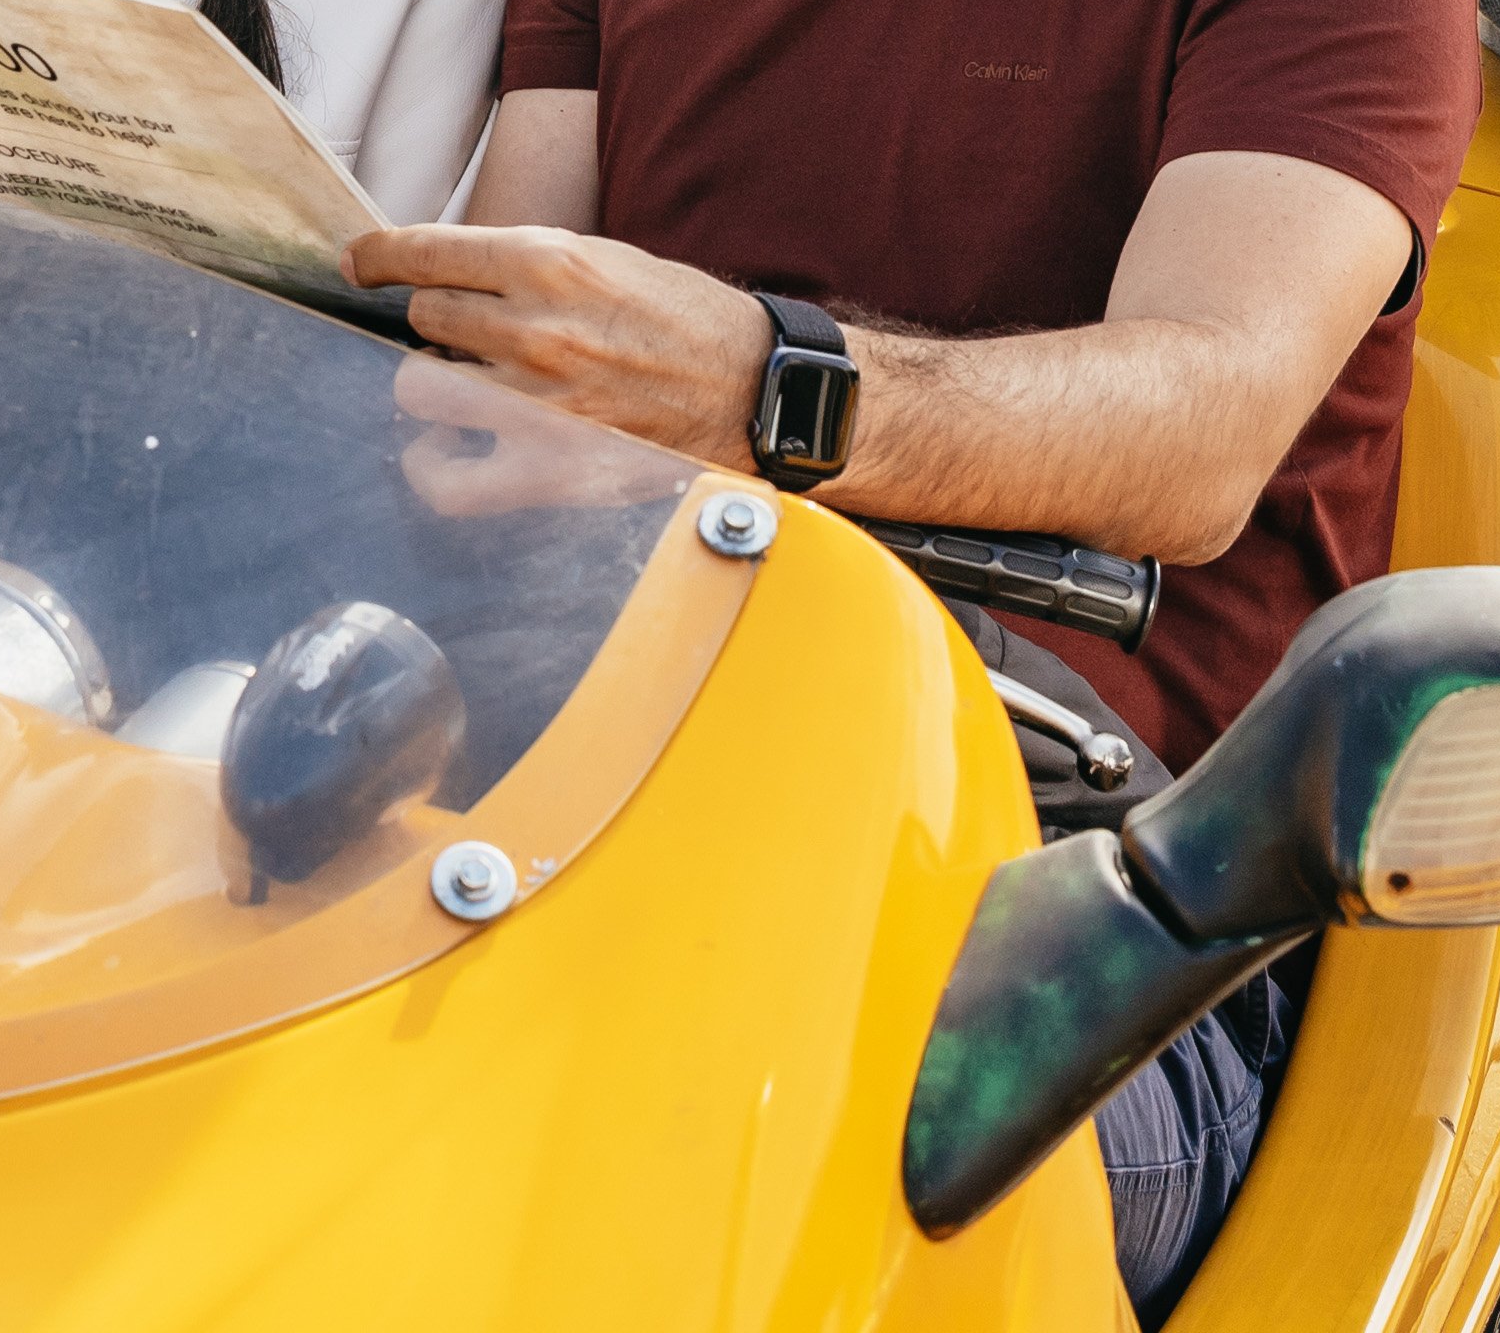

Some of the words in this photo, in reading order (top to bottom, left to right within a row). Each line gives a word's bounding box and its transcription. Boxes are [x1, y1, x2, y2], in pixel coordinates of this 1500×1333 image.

[964, 61, 1012, 81] Calvin
[1013, 63, 1049, 82] Klein
[3, 104, 33, 119] are
[37, 106, 82, 133] here
[83, 123, 105, 137] to
[107, 126, 161, 150] help!
[21, 92, 85, 121] during
[85, 107, 131, 126] your
[133, 114, 177, 134] tour
[53, 178, 86, 194] THE
[94, 186, 131, 207] LEFT
[133, 199, 195, 221] BRAKE
[54, 190, 102, 209] YOUR
[101, 201, 154, 223] RIGHT
